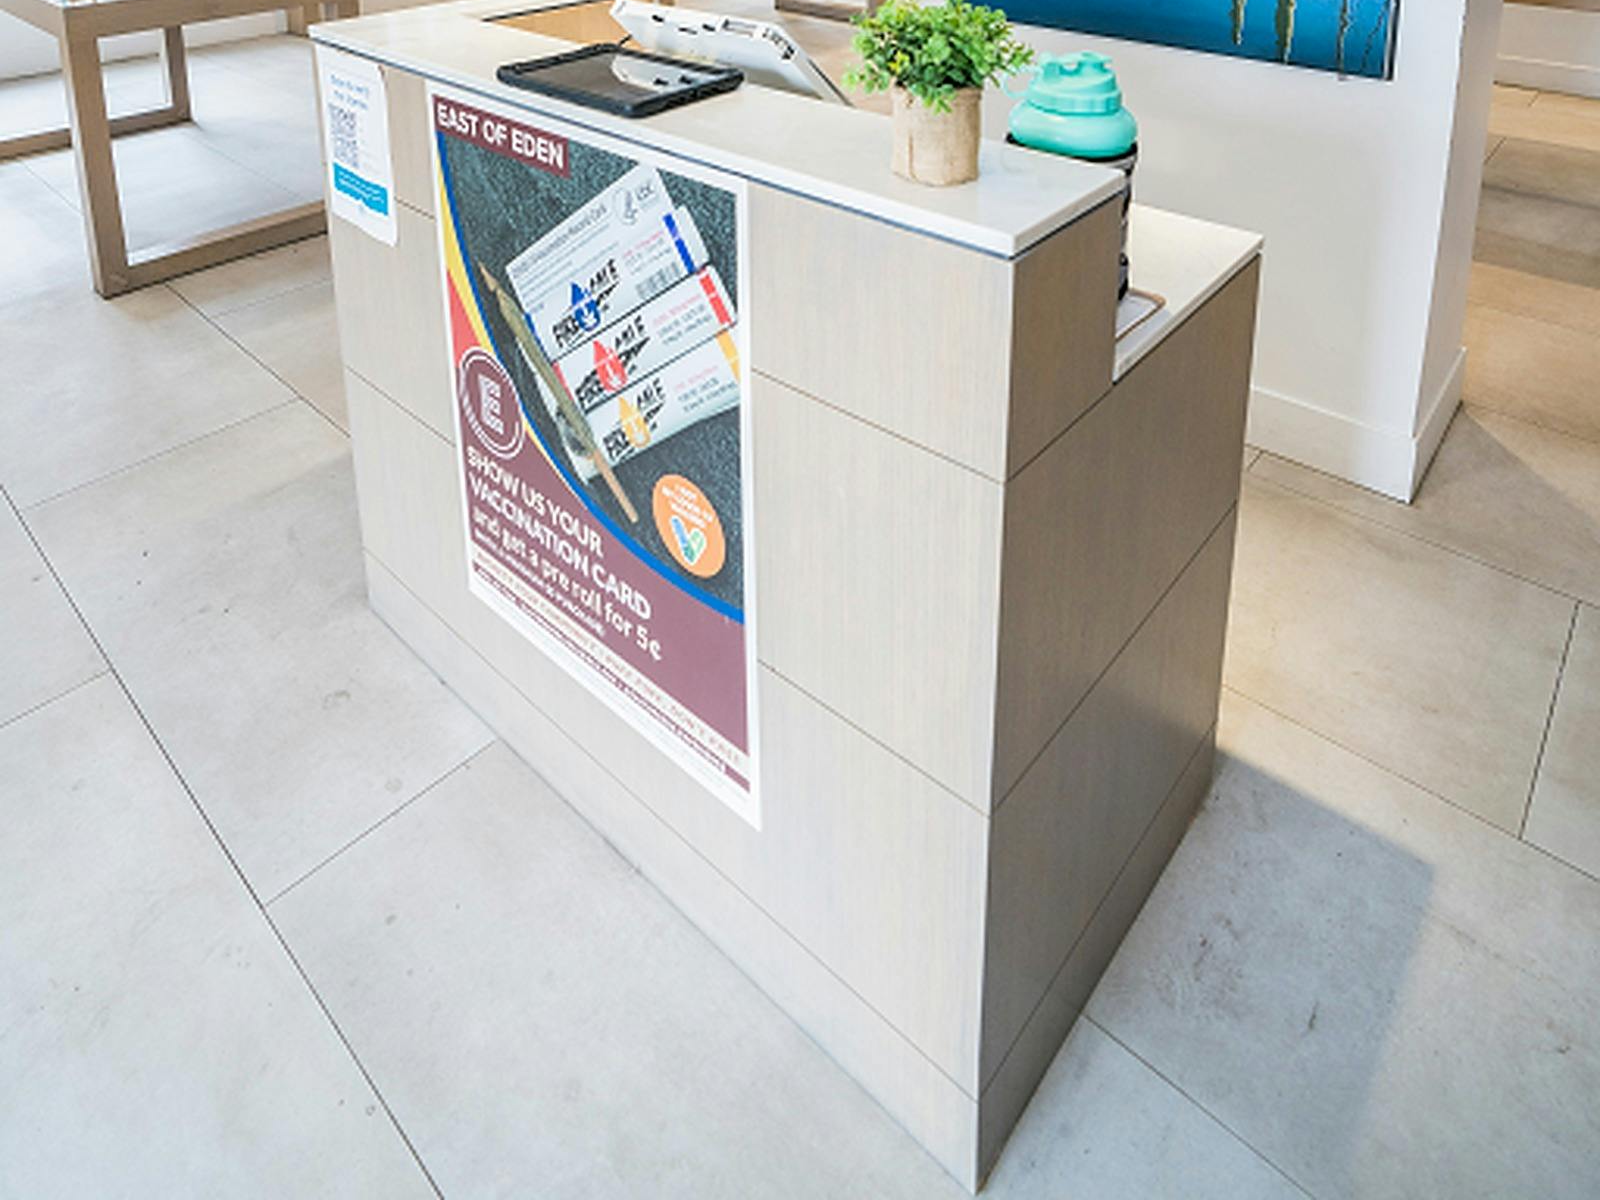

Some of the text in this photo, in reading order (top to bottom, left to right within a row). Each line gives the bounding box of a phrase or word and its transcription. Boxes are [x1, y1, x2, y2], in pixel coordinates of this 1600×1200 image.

[437, 103, 565, 169] EAST OF EDEN
[467, 445, 520, 497] SHOW
[521, 482, 545, 517] US
[546, 499, 605, 558] YOUR
[469, 471, 590, 577] VACCINATION
[592, 563, 652, 621] CARD
[473, 505, 499, 538] and
[604, 602, 633, 638] for
